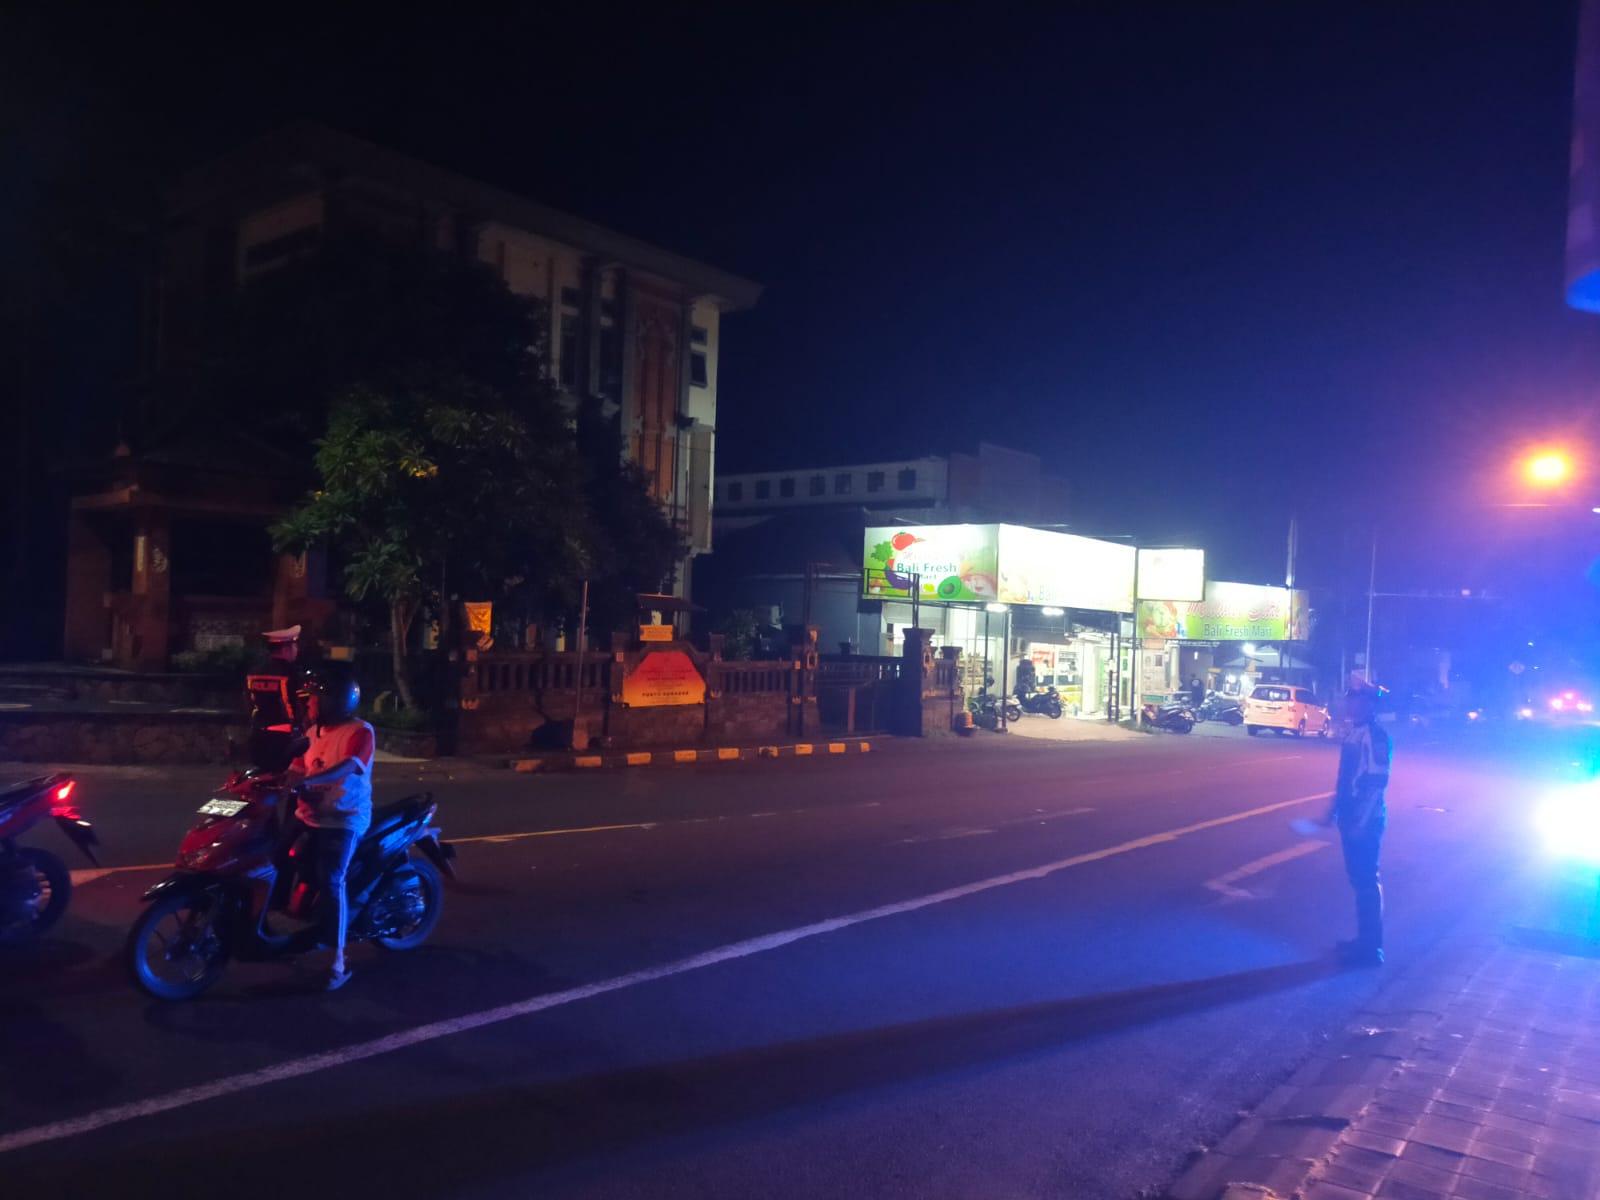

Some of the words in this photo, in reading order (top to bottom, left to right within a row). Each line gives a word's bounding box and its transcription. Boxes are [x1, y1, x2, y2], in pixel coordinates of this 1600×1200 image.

[896, 562, 919, 572] Bali
[923, 562, 957, 573] Fresh
[1204, 623, 1223, 637] Bali
[1225, 624, 1249, 637] Fresh
[1252, 624, 1272, 637] Mart
